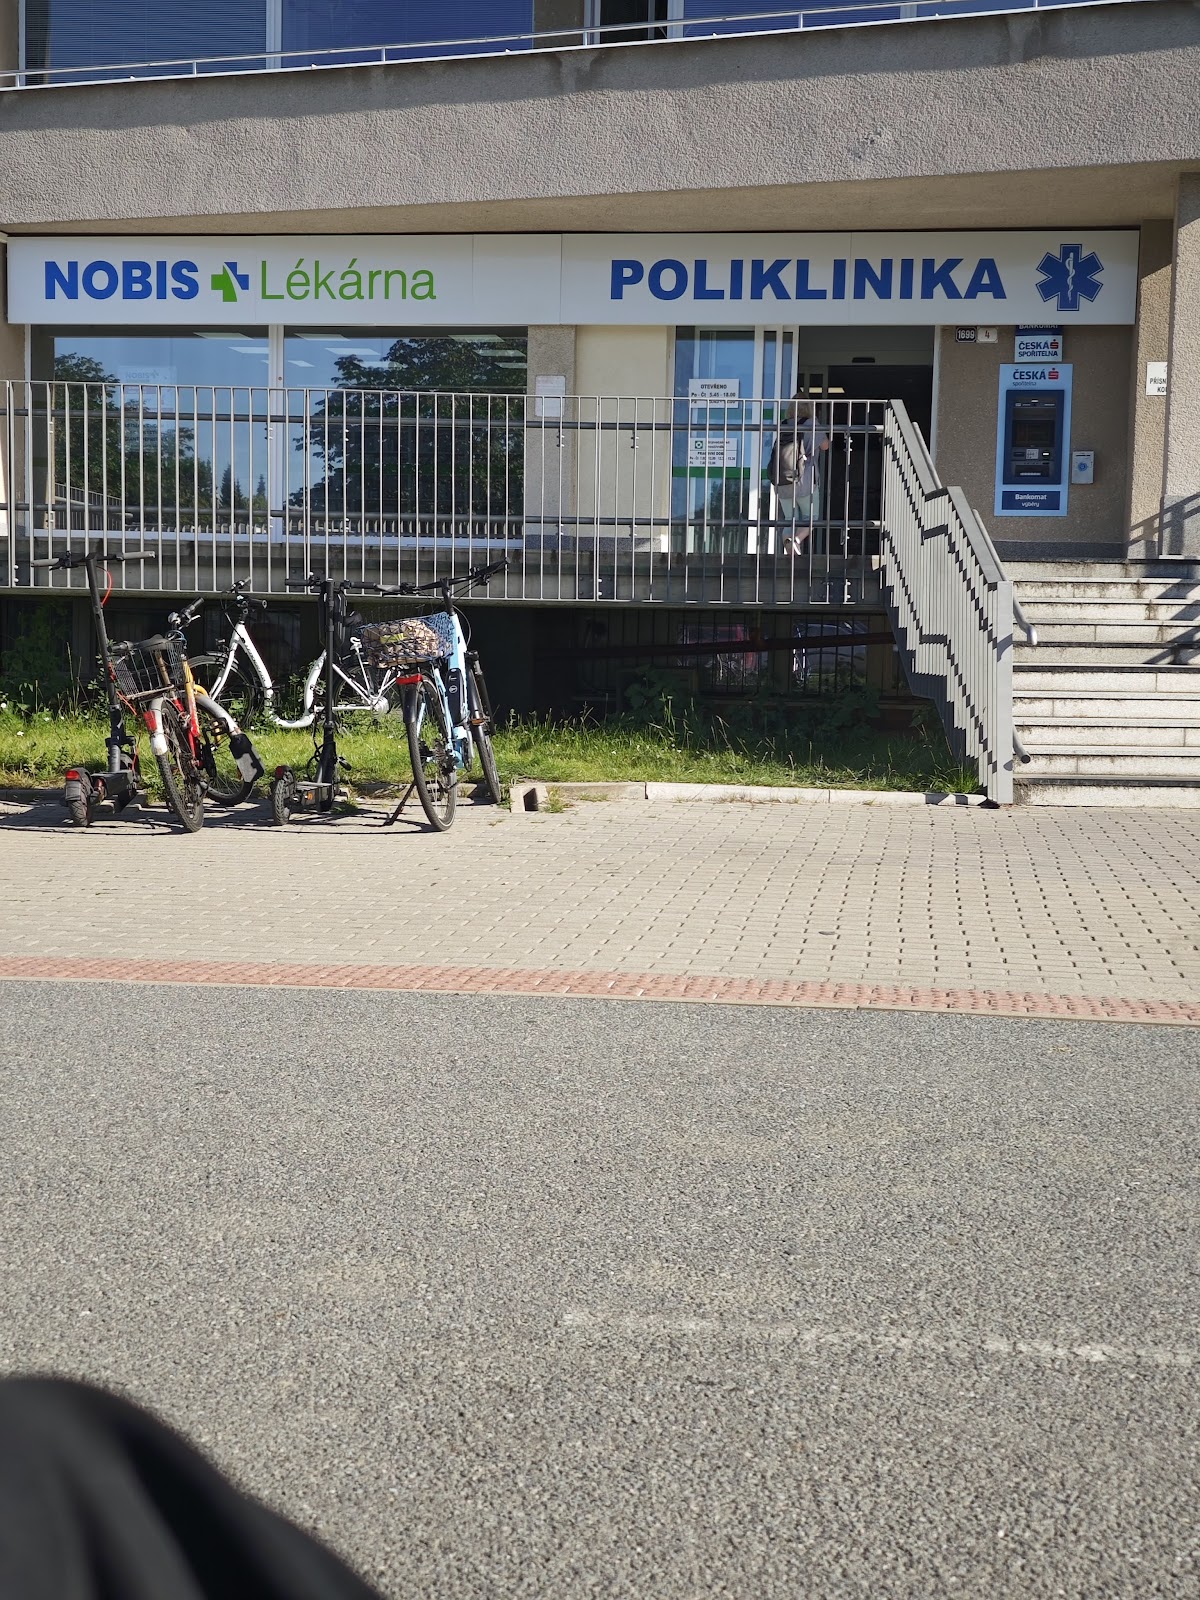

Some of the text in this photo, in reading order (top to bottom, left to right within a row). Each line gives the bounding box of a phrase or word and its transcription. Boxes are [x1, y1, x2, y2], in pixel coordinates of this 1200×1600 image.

[44, 257, 437, 300] NOBIS Lékárna
[610, 258, 1007, 300] POLIKLINIKA
[958, 330, 976, 339] 1699
[984, 330, 990, 338] 4
[1018, 340, 1049, 350] ČESKÁ
[1012, 368, 1046, 380] ČESKÁ
